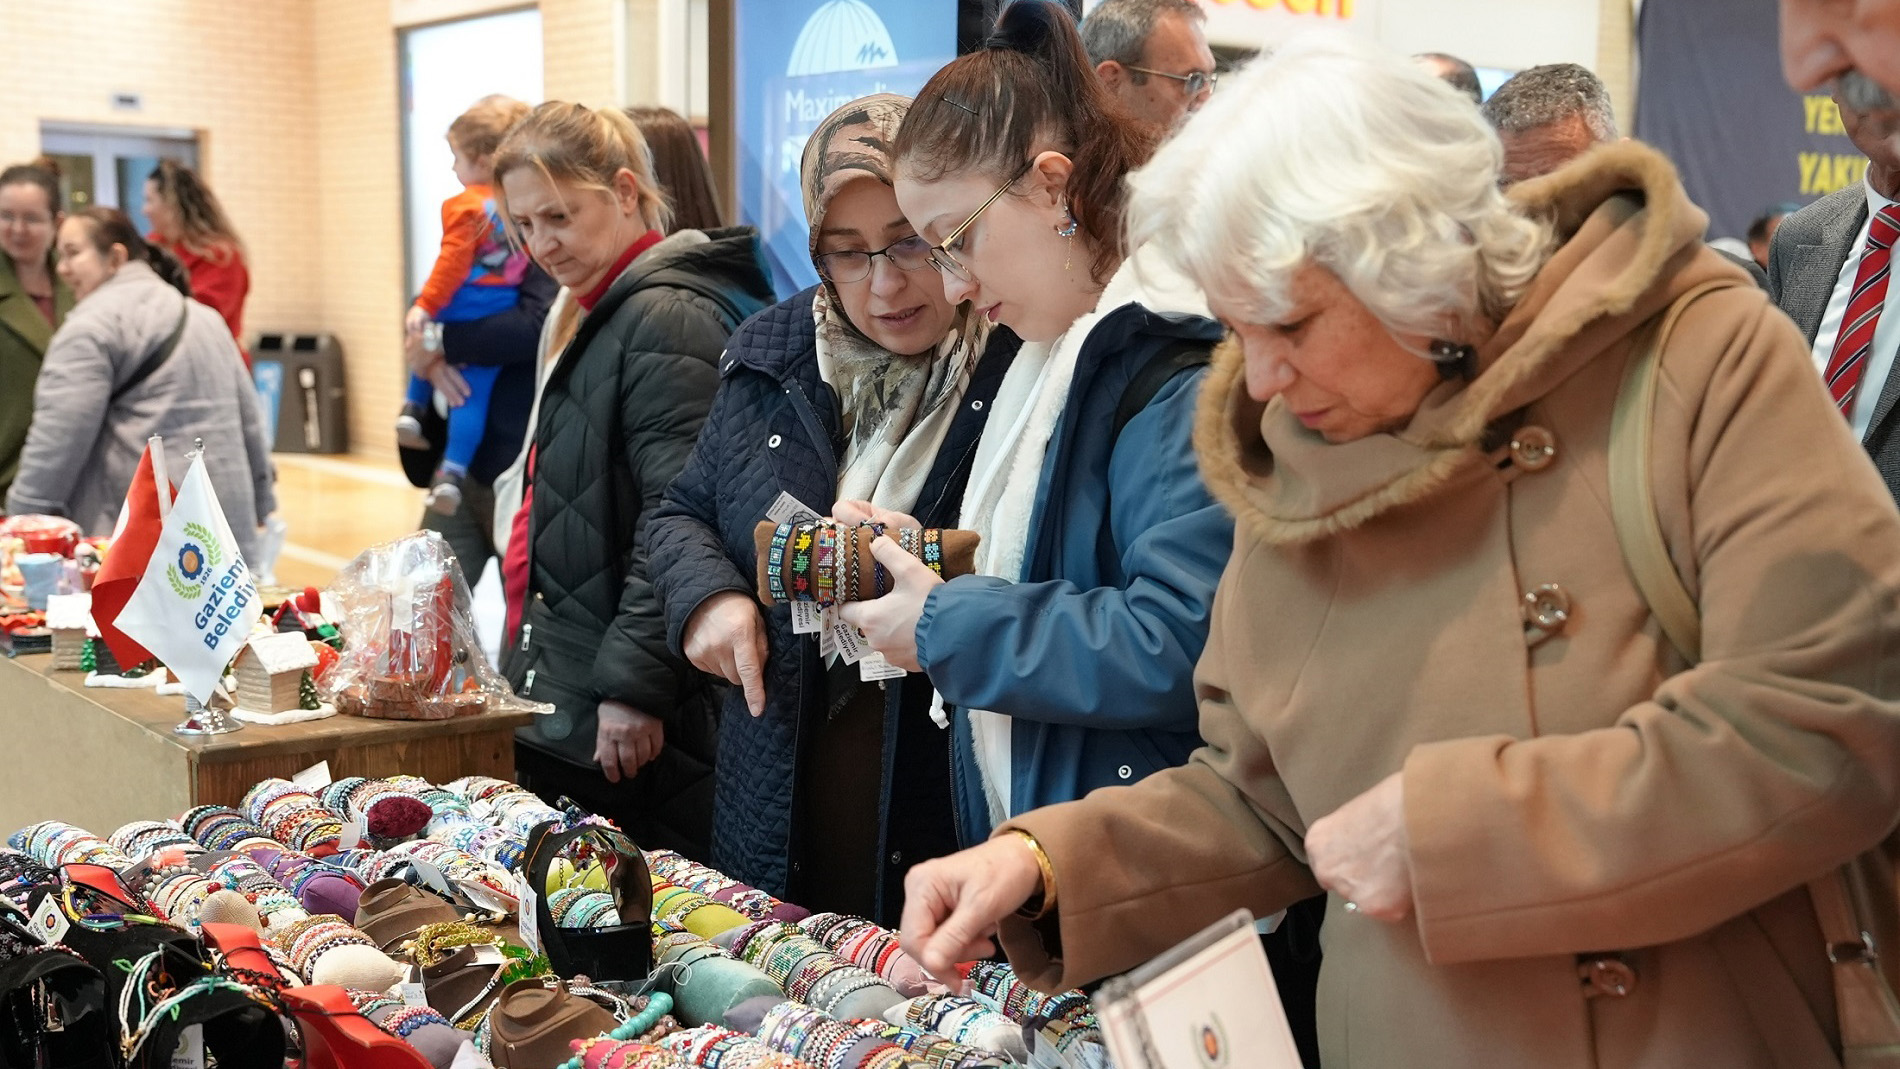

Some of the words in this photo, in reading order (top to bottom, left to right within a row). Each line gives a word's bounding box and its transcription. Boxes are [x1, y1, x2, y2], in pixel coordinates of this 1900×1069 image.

[1803, 95, 1848, 134] YE
[200, 566, 213, 585] 1926
[833, 624, 854, 659] Belediyesi
[840, 623, 859, 653] Gaziemir
